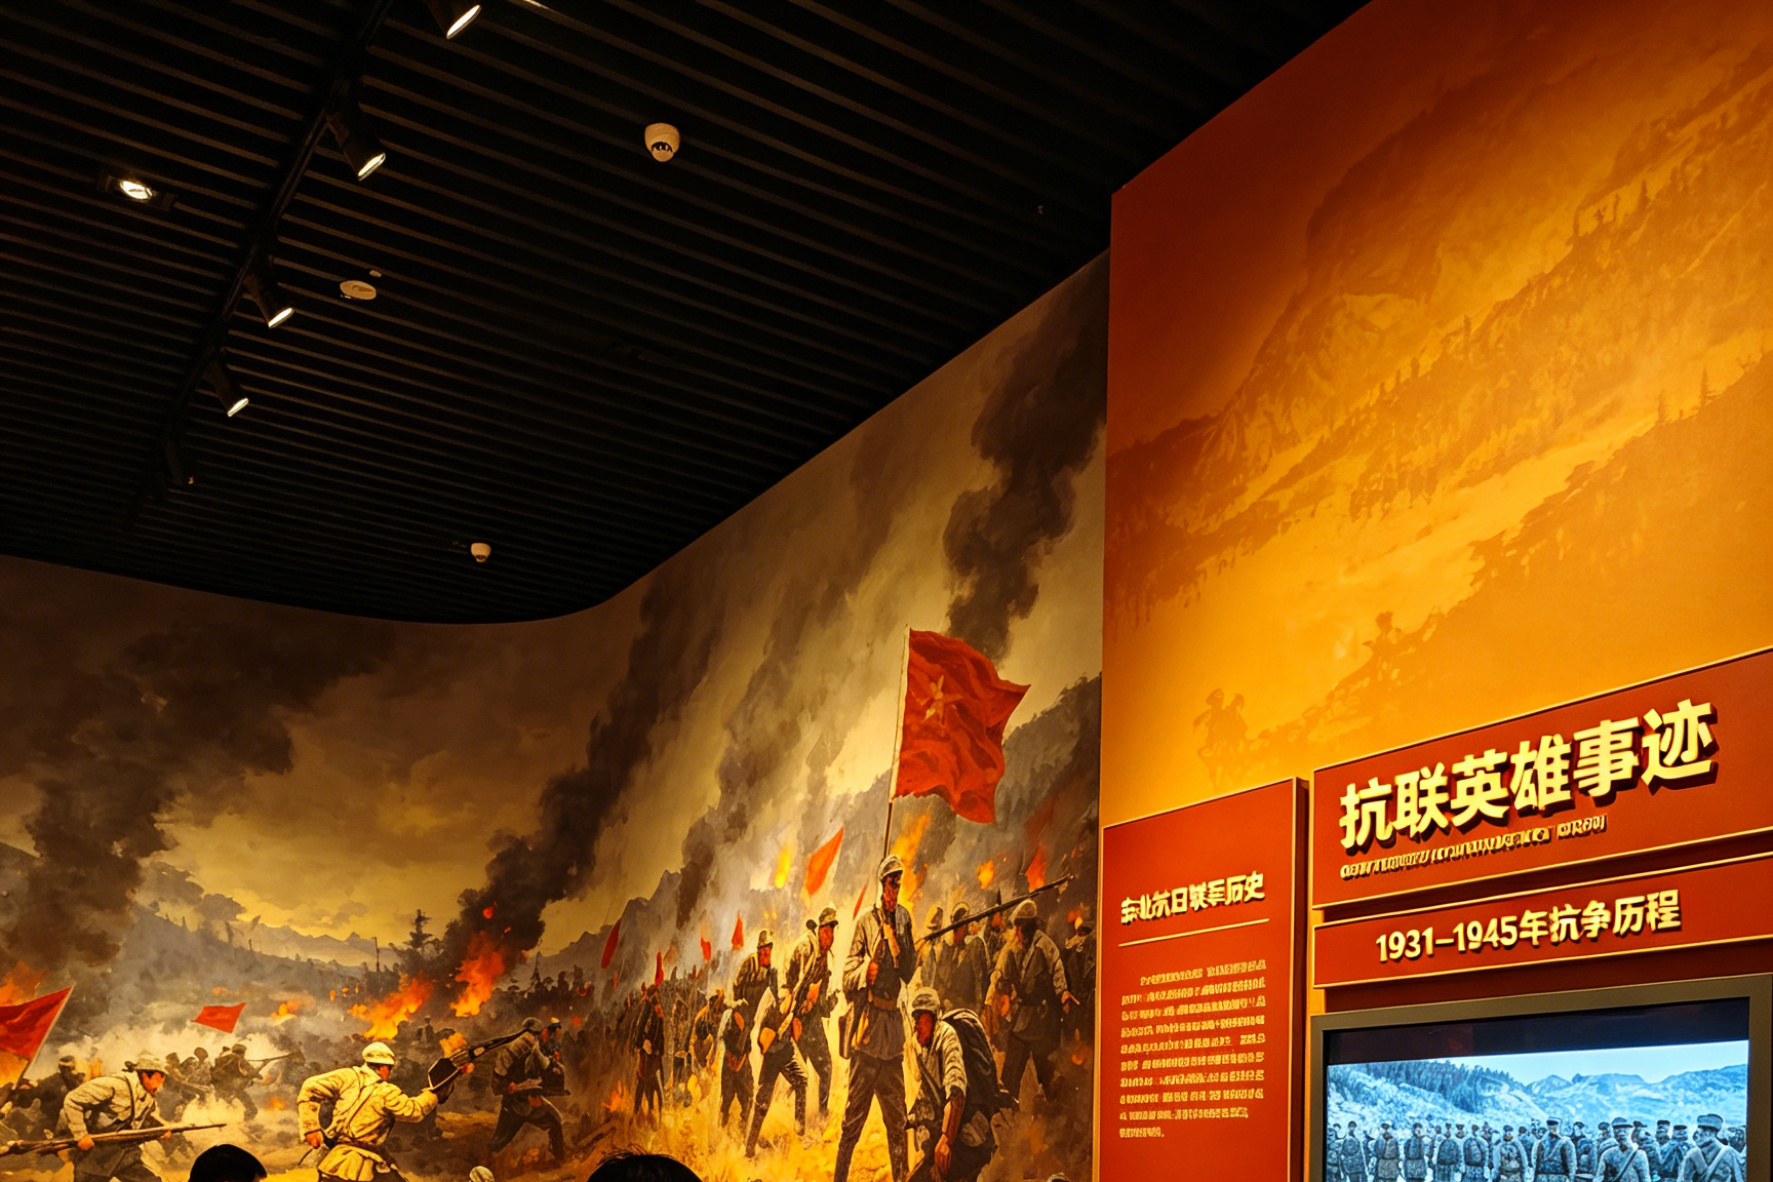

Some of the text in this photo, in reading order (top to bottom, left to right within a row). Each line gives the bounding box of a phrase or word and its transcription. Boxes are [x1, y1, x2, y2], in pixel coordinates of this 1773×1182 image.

[1340, 698, 1713, 849] 抗联英雄事迹
[1376, 889, 1682, 962] 1931-1945年抗争历程
